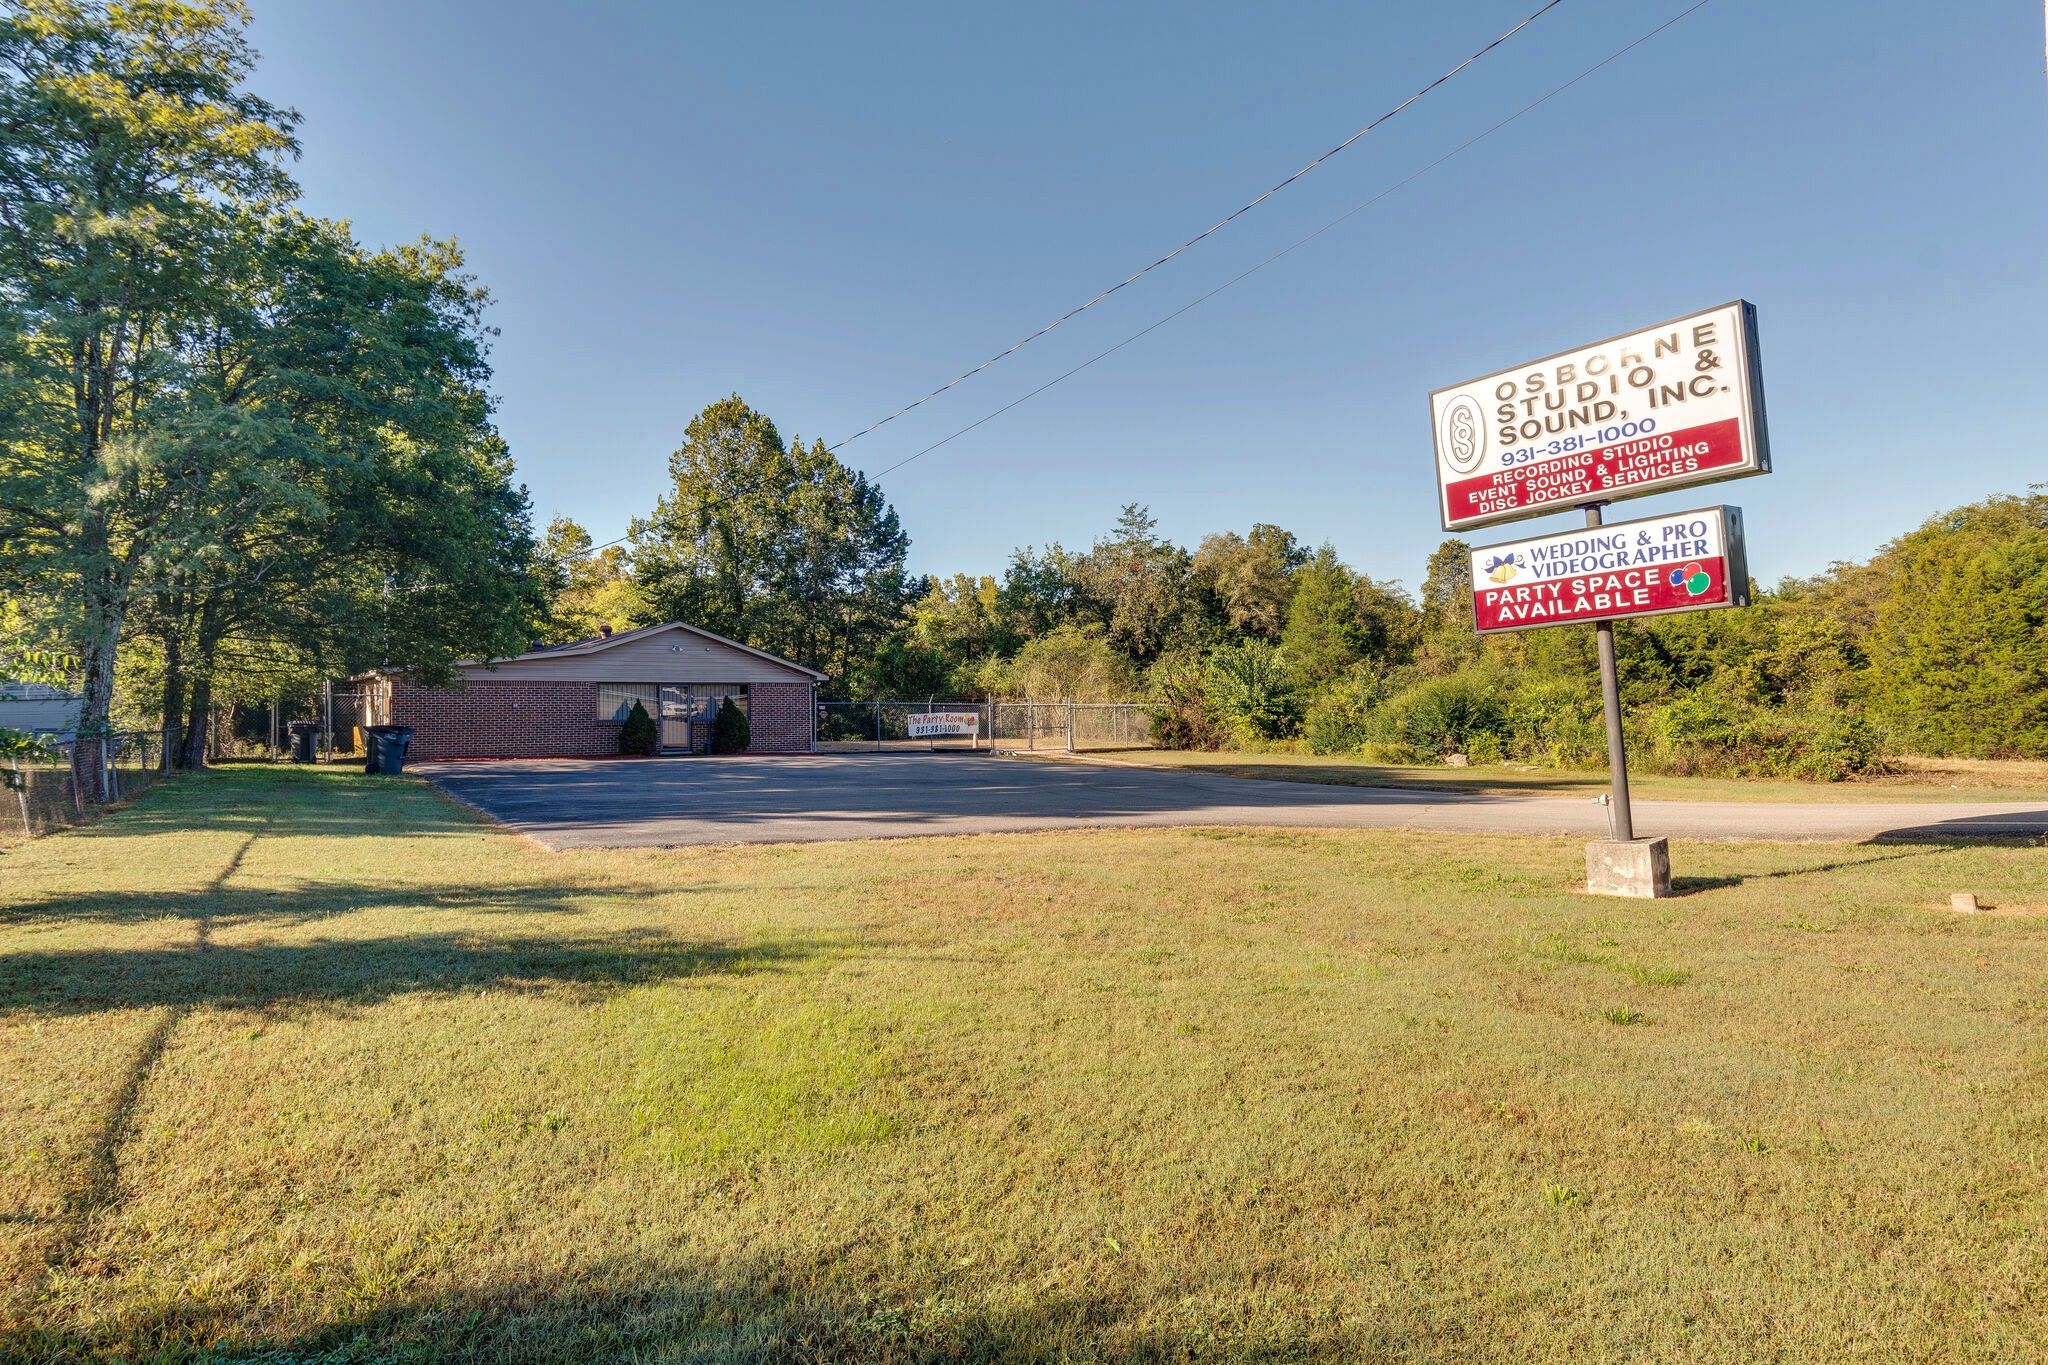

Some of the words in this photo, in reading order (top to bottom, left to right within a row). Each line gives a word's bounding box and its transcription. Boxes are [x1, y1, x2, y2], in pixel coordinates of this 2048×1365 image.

[1497, 366, 1655, 423] STUDIO
[1695, 349, 1722, 372] &
[1499, 401, 1627, 445] SOUND,
[1649, 375, 1729, 409] INC.
[1493, 454, 1593, 485] RECORDING
[1603, 435, 1673, 460] STUDIO
[1501, 418, 1656, 466] 931-381-1000
[1469, 483, 1518, 504] EVENT
[1526, 468, 1586, 491] SOUND
[1596, 465, 1608, 476] &
[1618, 441, 1710, 472] LIGHTING
[1479, 496, 1518, 514] DISC
[1526, 480, 1593, 504] JOCKEY
[1602, 458, 1699, 488] SERVICES
[1530, 533, 1626, 562] WEDDING
[1637, 530, 1652, 546] &
[1662, 520, 1707, 542] PRO
[1531, 539, 1709, 579] VIDEOGRAPHER
[1486, 582, 1562, 607] PARTY
[1572, 568, 1661, 595] SPACE
[1498, 588, 1651, 622] AVAILABLE
[909, 715, 921, 725] The
[922, 714, 944, 725] Party
[945, 713, 964, 723] Room
